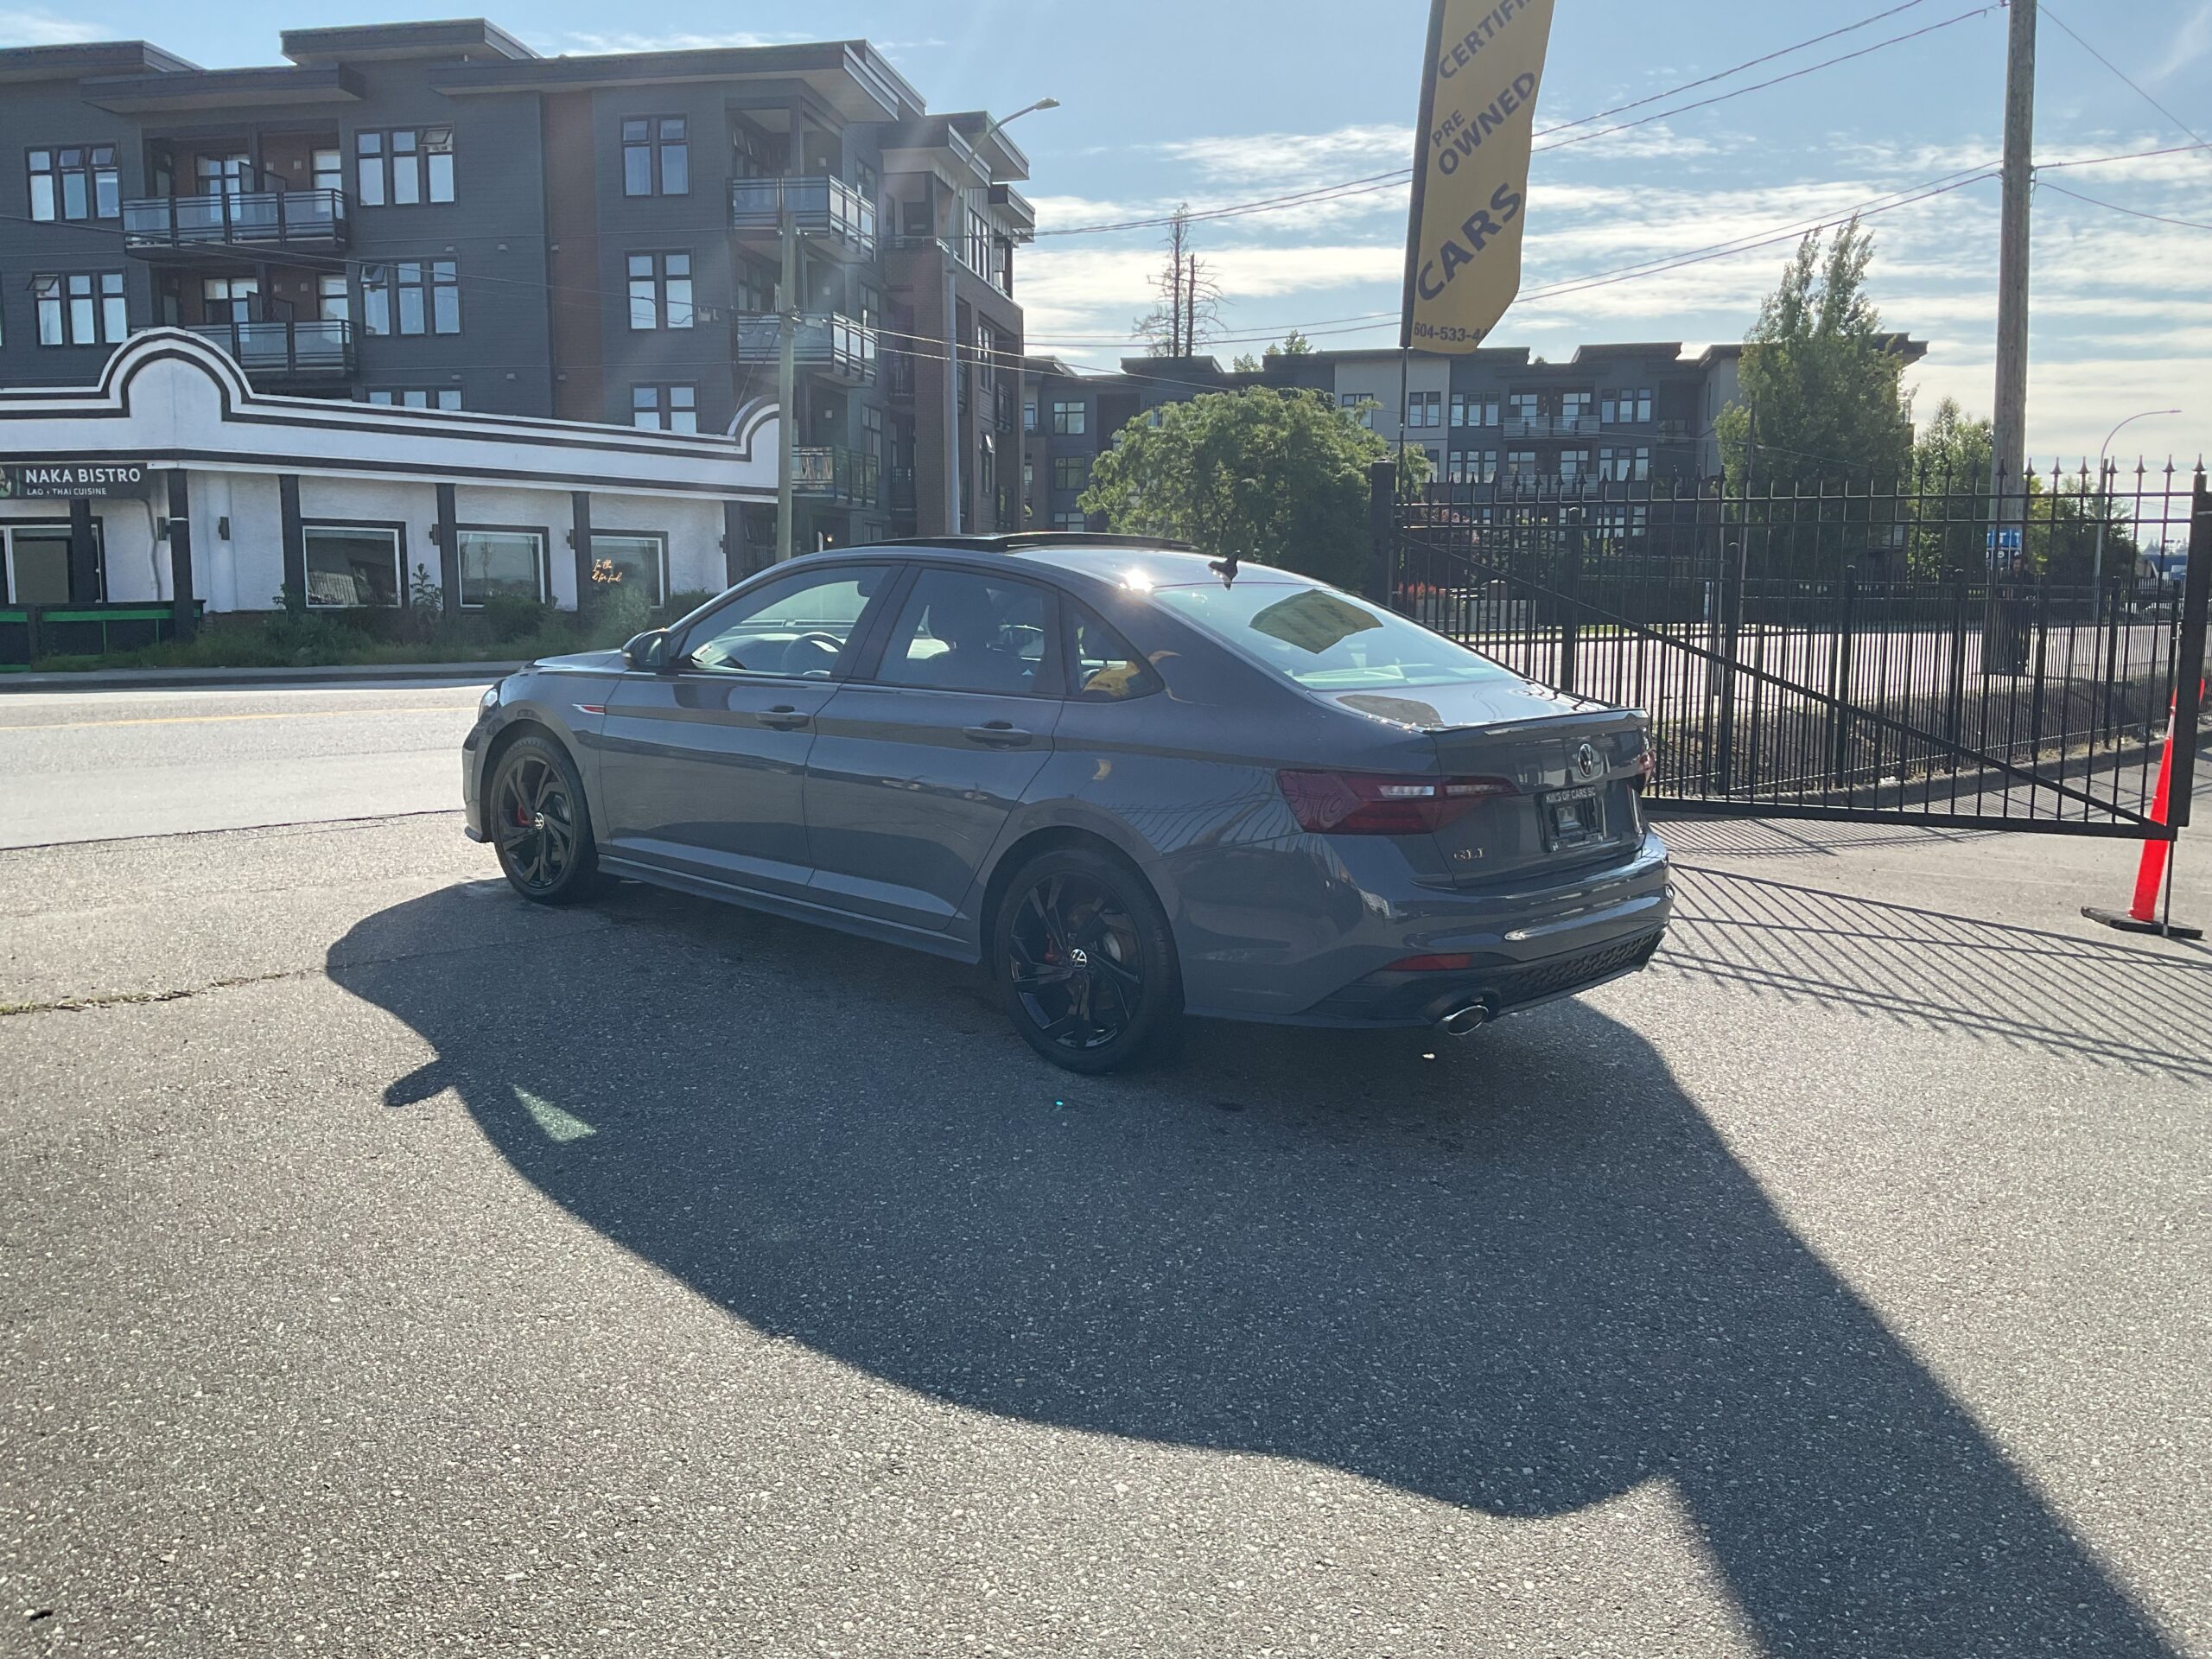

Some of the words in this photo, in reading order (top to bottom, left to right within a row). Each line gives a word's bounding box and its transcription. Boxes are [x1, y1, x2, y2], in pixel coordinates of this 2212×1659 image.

[1432, 109, 1465, 148] PRE
[1439, 72, 1535, 175] OWNED
[1417, 182, 1521, 301] CARS
[25, 469, 73, 483] NAKA
[78, 467, 141, 482] BISTRO
[1546, 791, 1561, 804] KING
[1562, 791, 1570, 801] OF
[1571, 788, 1587, 799] CARS
